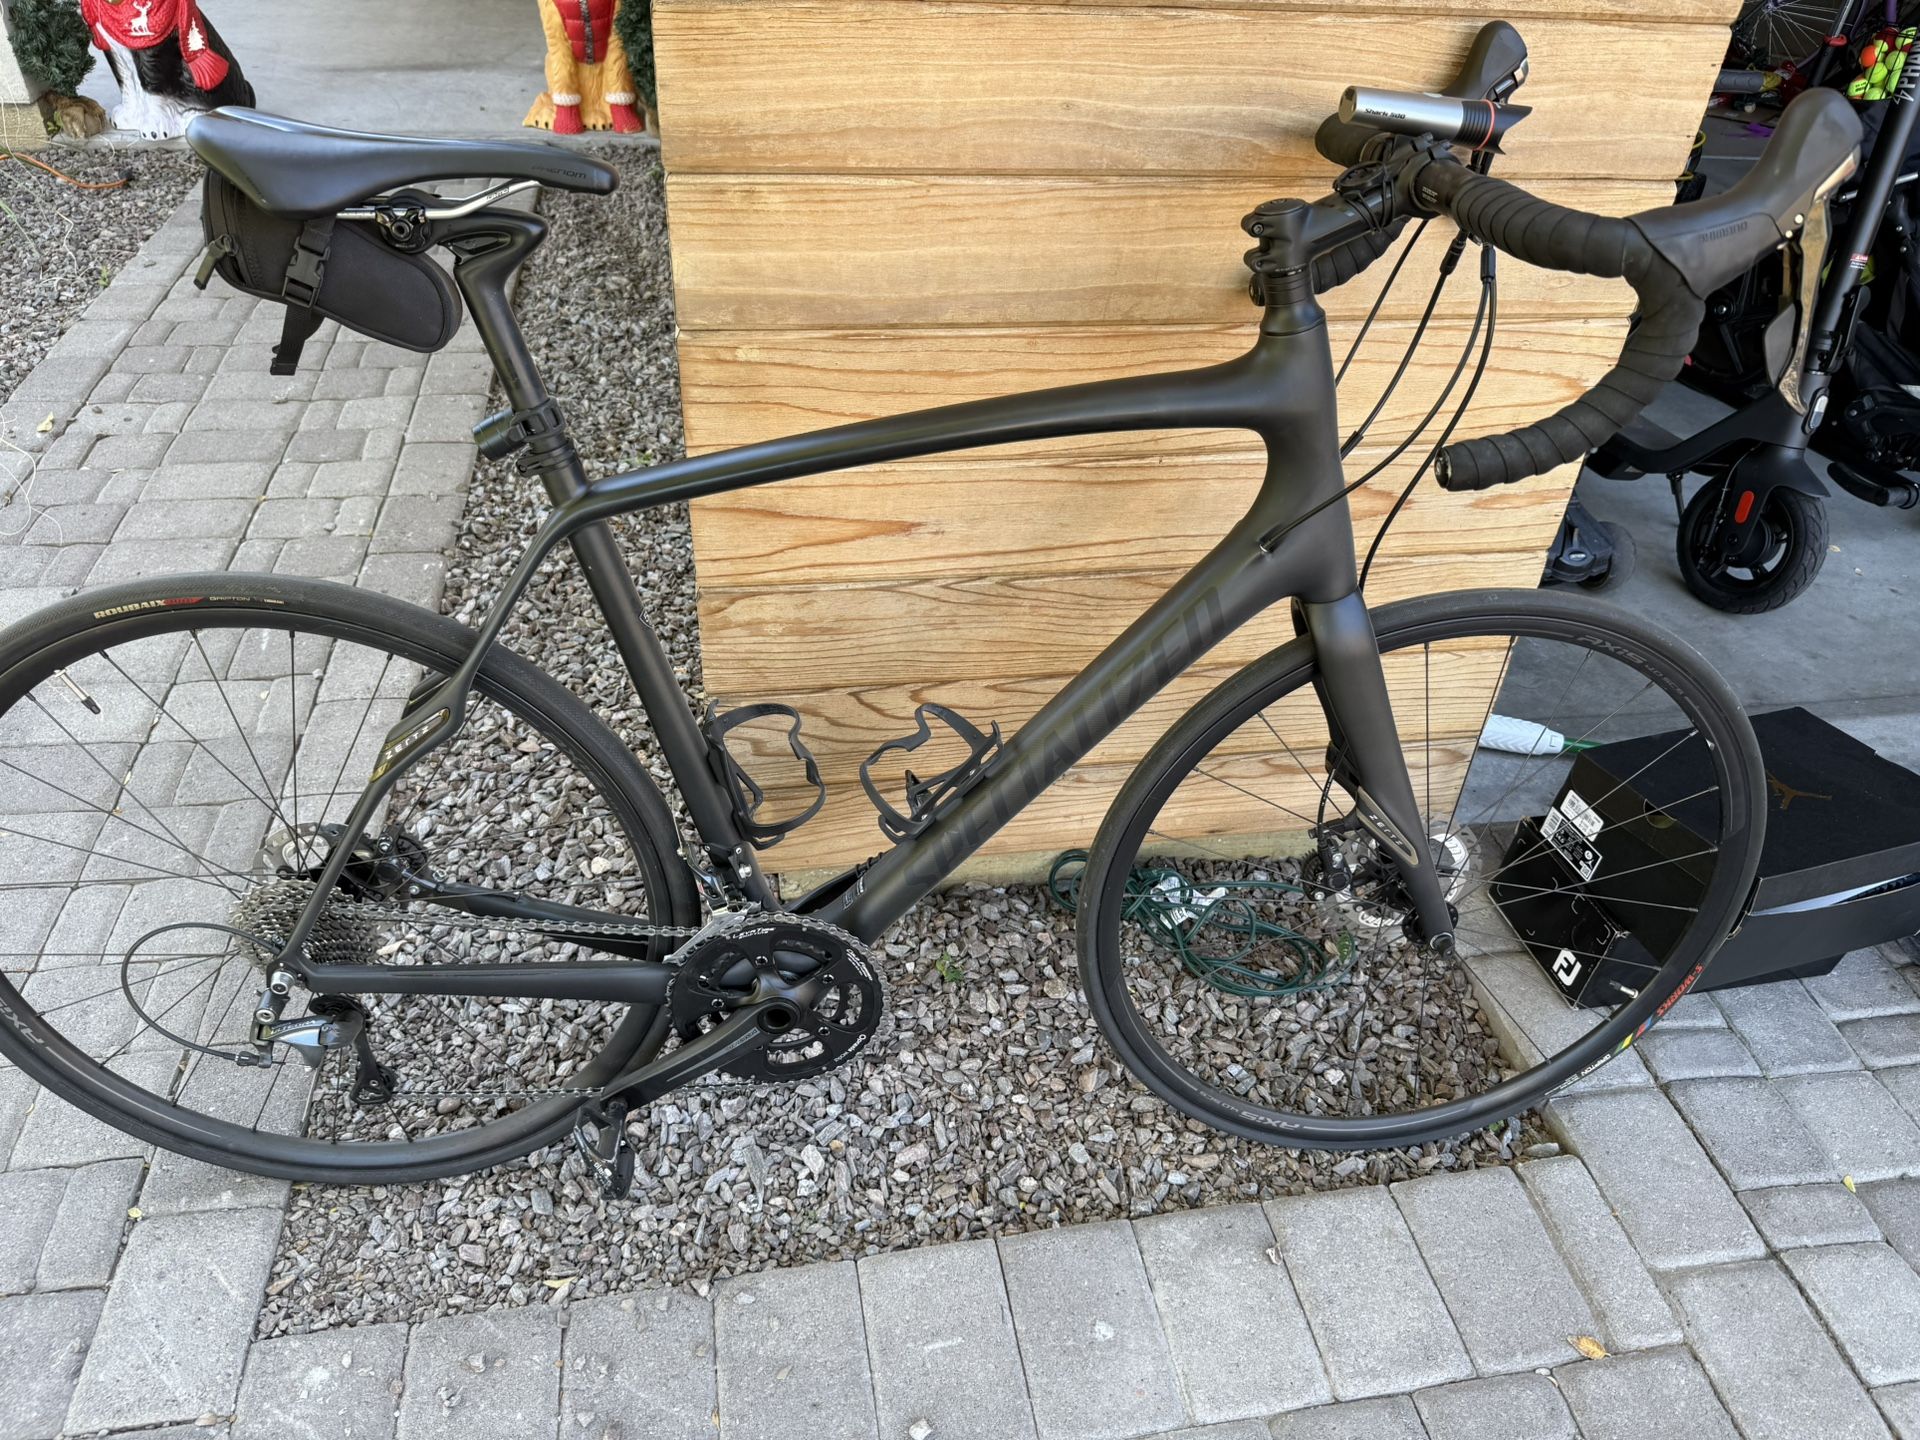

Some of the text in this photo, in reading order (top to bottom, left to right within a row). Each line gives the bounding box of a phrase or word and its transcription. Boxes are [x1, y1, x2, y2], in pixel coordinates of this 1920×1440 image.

[1365, 107, 1388, 117] Shark
[93, 599, 166, 619] ROUBAIX
[1656, 963, 1704, 1017] S-WORKS
